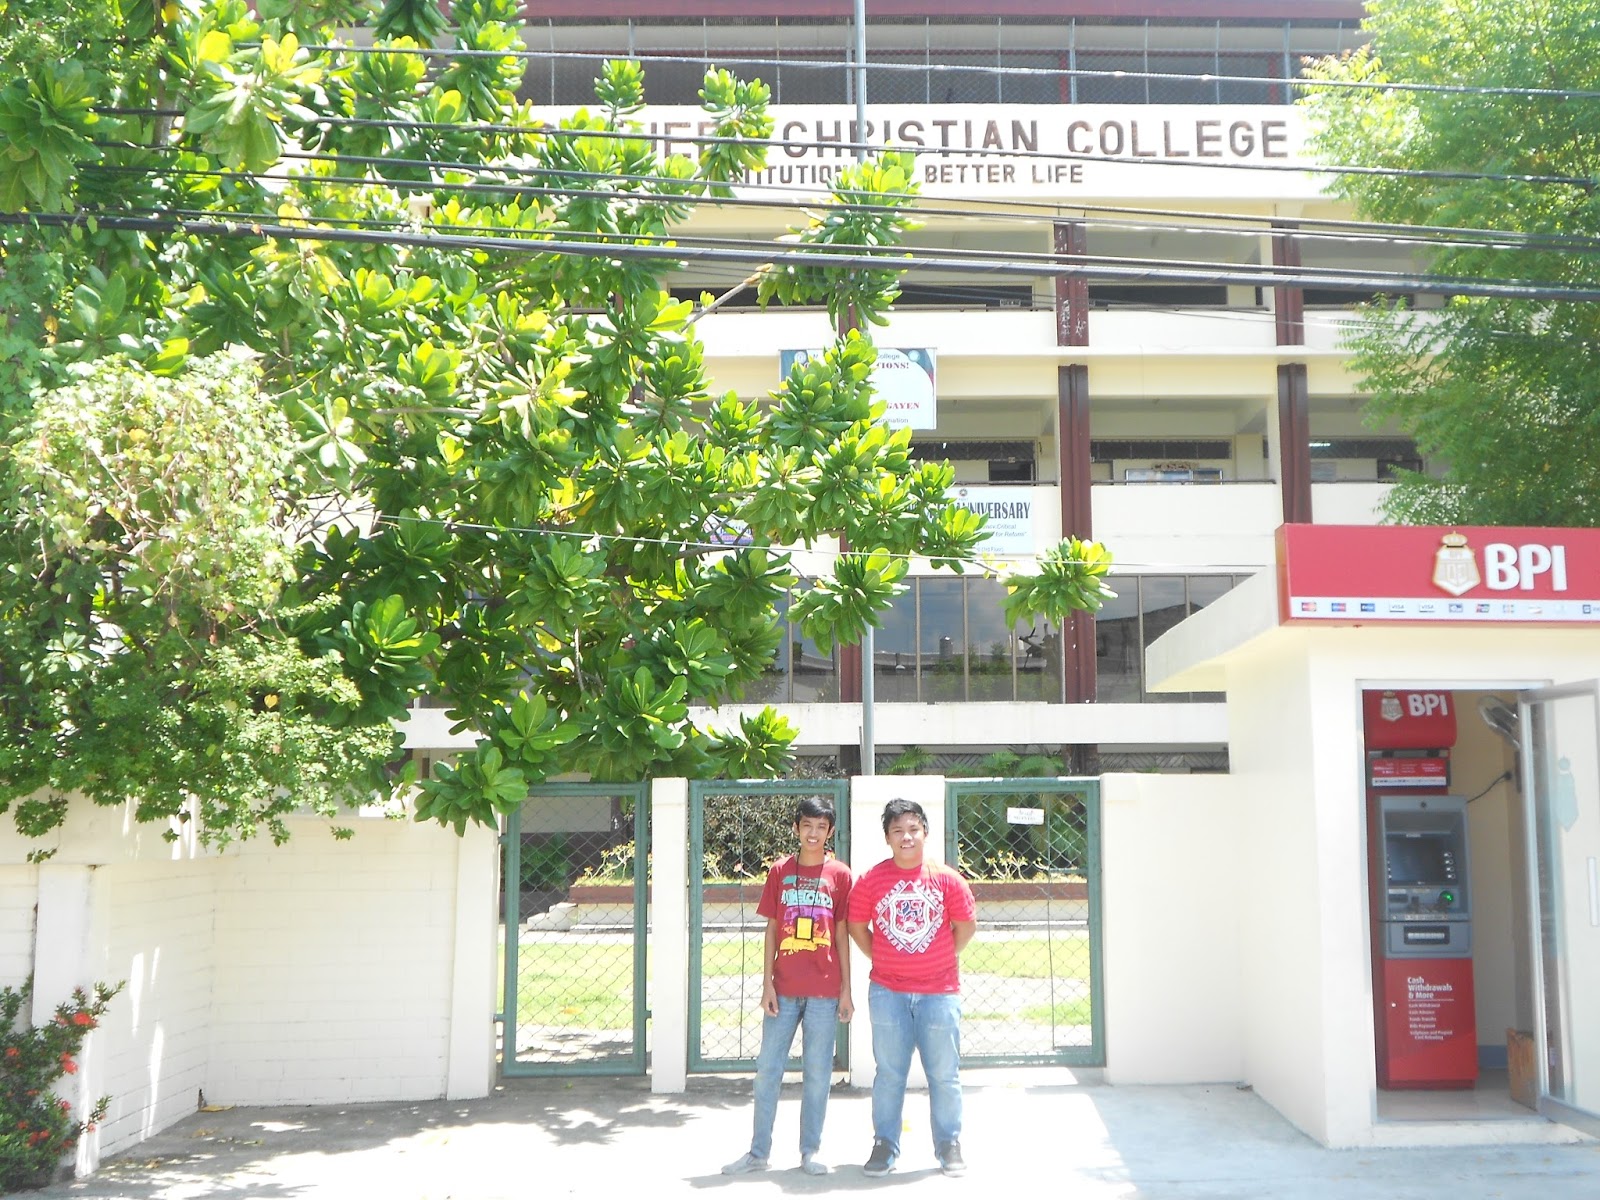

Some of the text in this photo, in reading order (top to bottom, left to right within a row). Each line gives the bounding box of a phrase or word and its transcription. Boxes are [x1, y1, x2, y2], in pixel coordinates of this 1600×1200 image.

[783, 120, 1038, 157] CHRISTIAN
[1067, 120, 1288, 158] COLLEGE
[925, 164, 1015, 184] BETTER
[1032, 164, 1083, 184] LIFE
[956, 502, 1031, 519] NIVERSARY
[1484, 543, 1568, 592] BPI
[1407, 693, 1448, 716] BPI
[1407, 976, 1424, 984] Cash
[1408, 983, 1453, 991] Withdrawals
